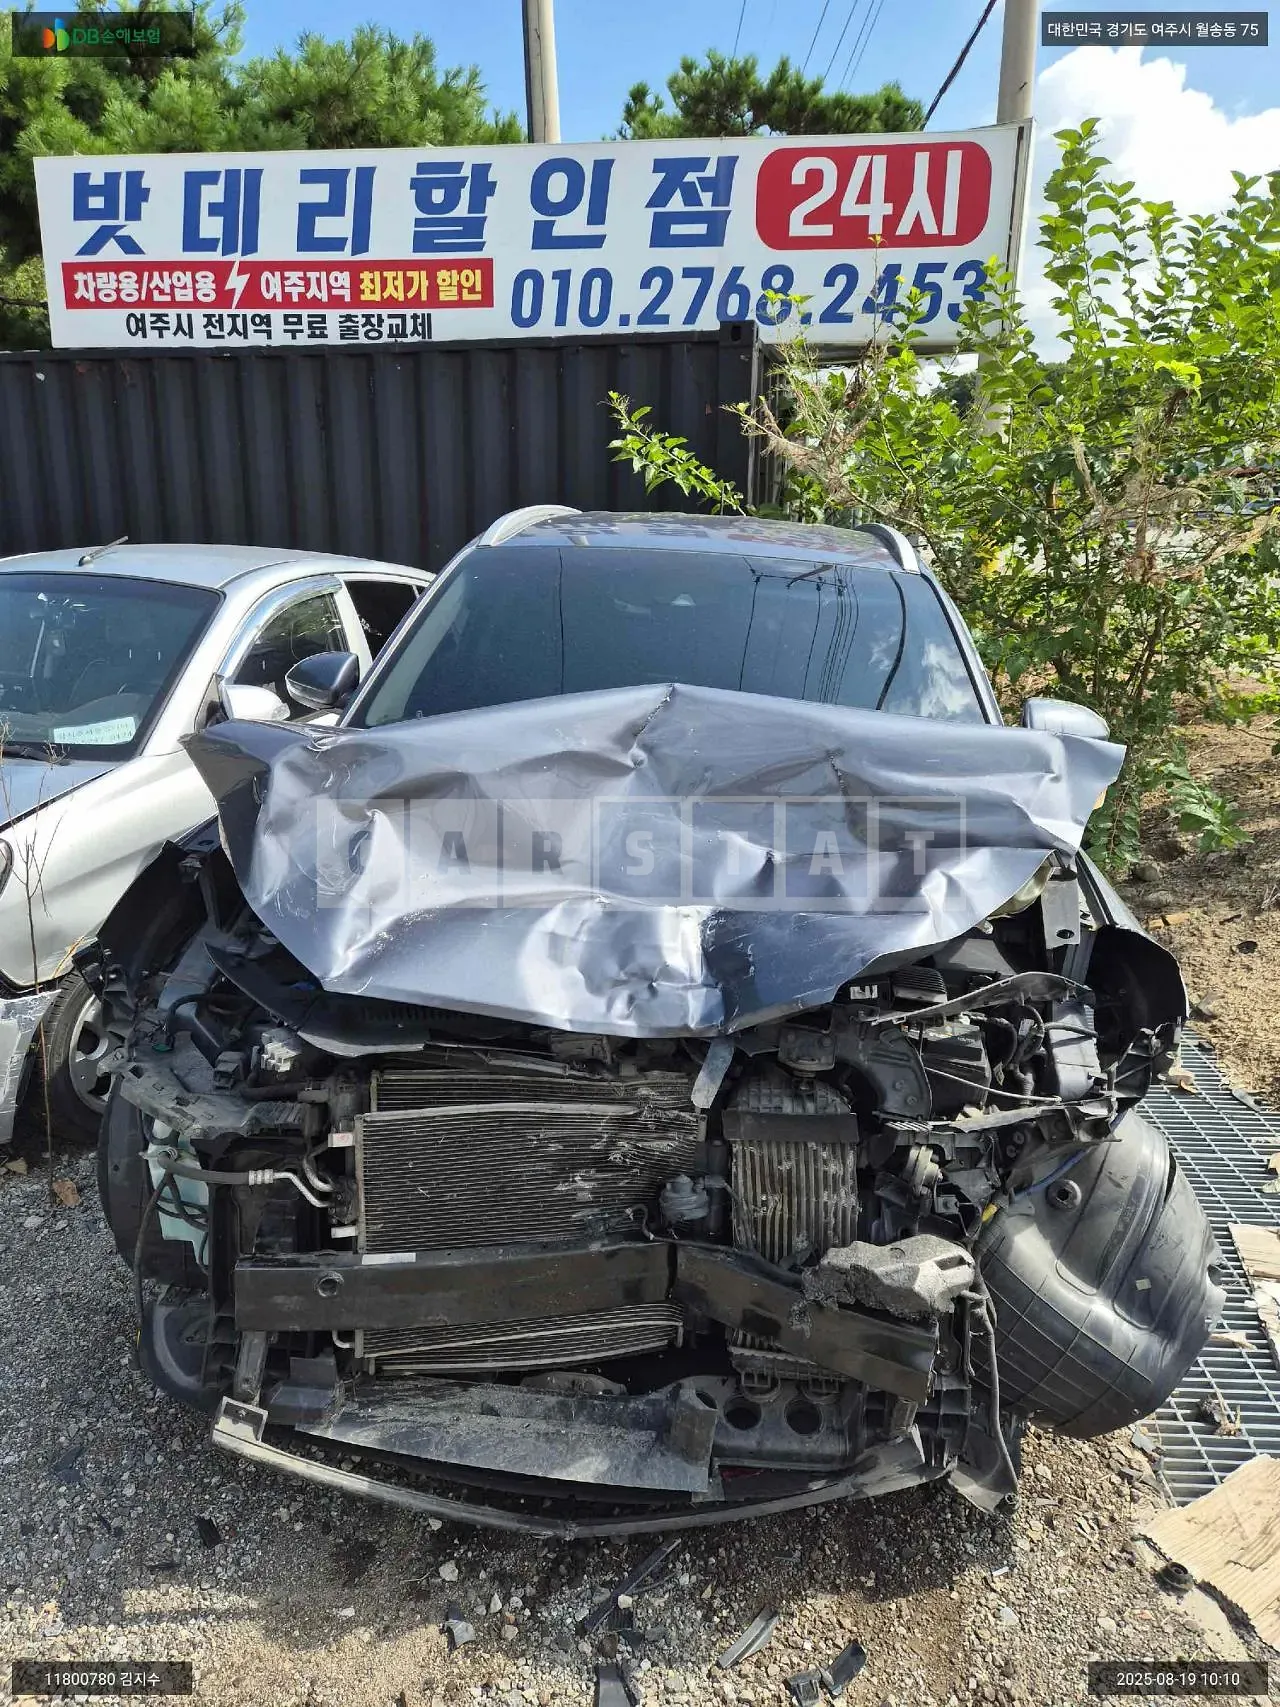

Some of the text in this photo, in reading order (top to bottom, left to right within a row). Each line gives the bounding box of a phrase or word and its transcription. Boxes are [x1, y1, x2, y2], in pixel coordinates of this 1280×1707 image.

[789, 149, 962, 238] 24시
[73, 268, 482, 303] 차량용/산업용 여주지역 최저가 할인
[510, 259, 988, 329] 010.2768.2453
[126, 312, 433, 341] 여주시 전지역 무료 출장교체
